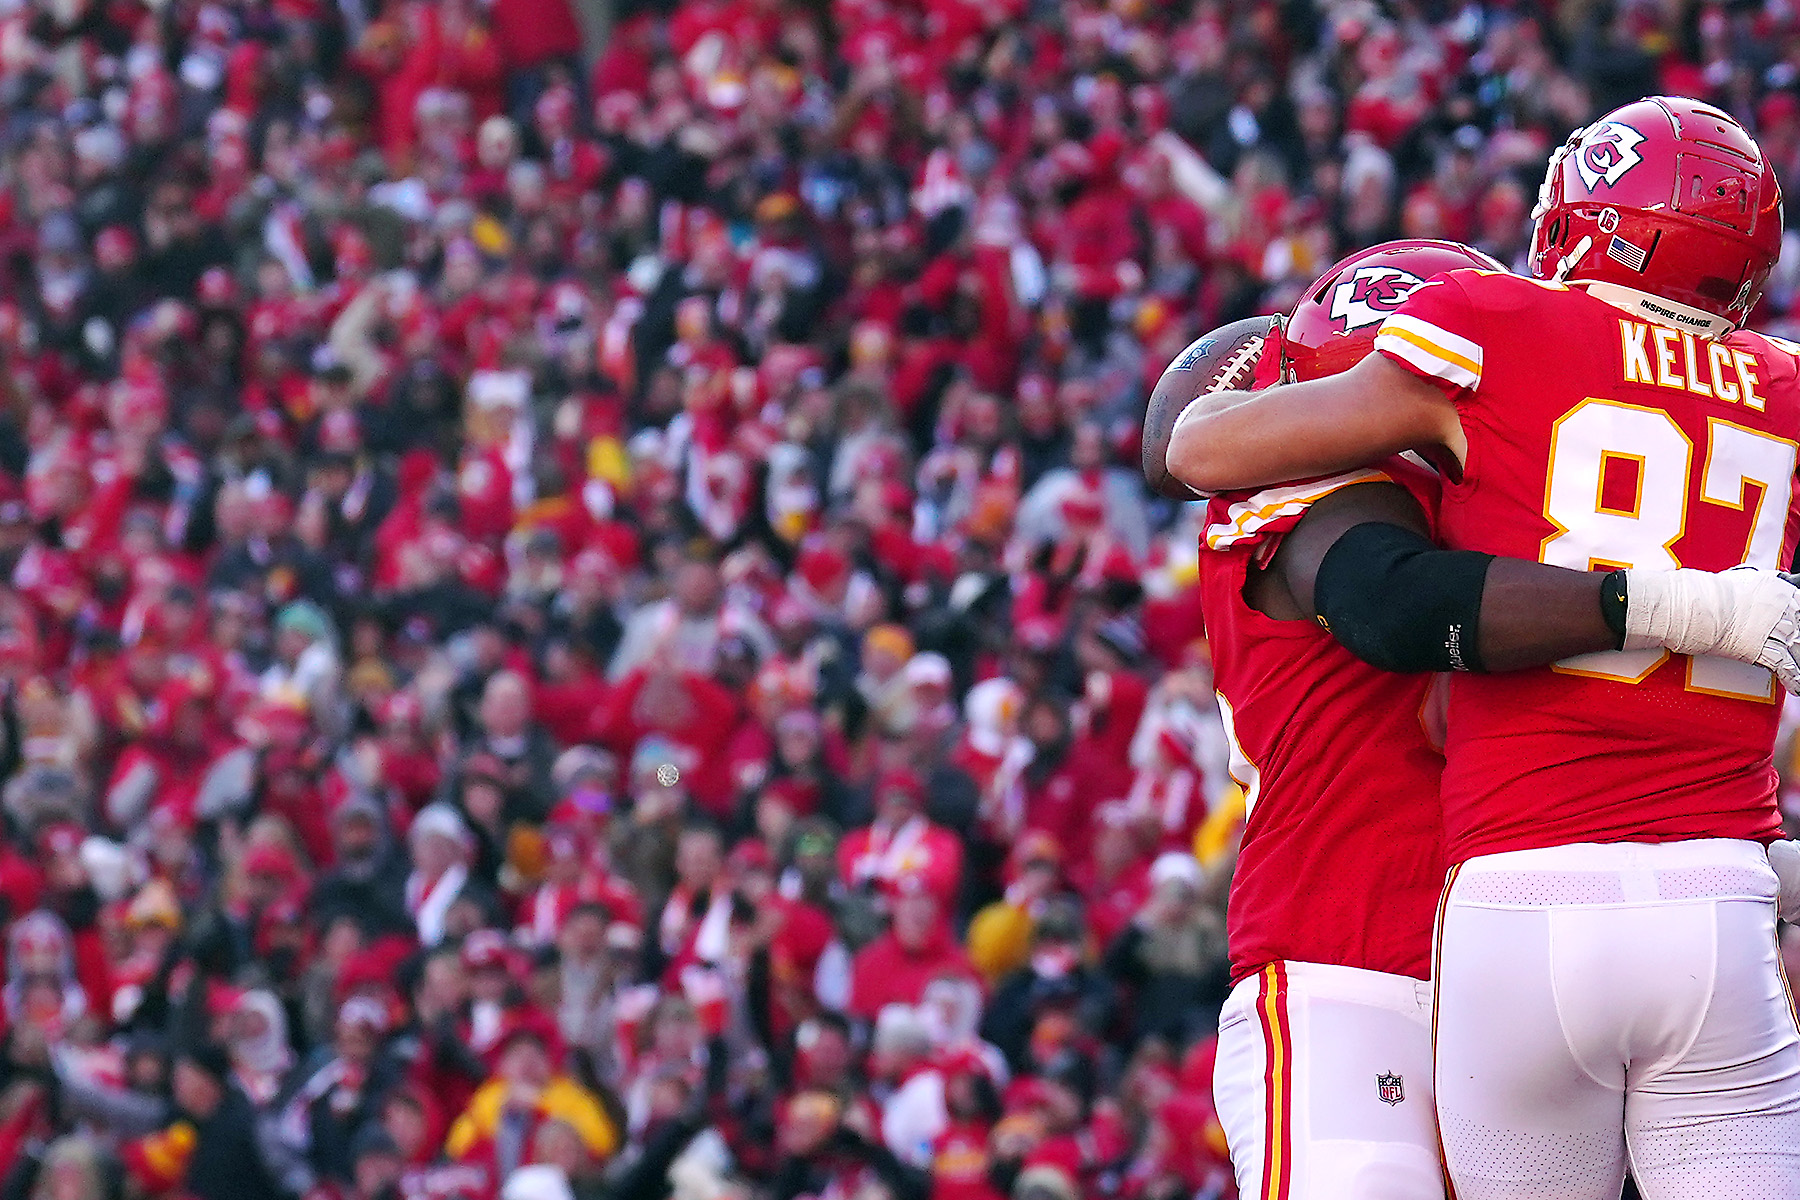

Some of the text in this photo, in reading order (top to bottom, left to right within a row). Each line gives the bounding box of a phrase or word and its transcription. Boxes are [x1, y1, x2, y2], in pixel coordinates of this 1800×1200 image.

[1599, 209, 1617, 231] 16
[1640, 299, 1713, 328] INSPIRE CHANGE
[1618, 318, 1767, 413] KELCE
[1538, 396, 1799, 705] 87
[1381, 1086, 1401, 1100] NFL
